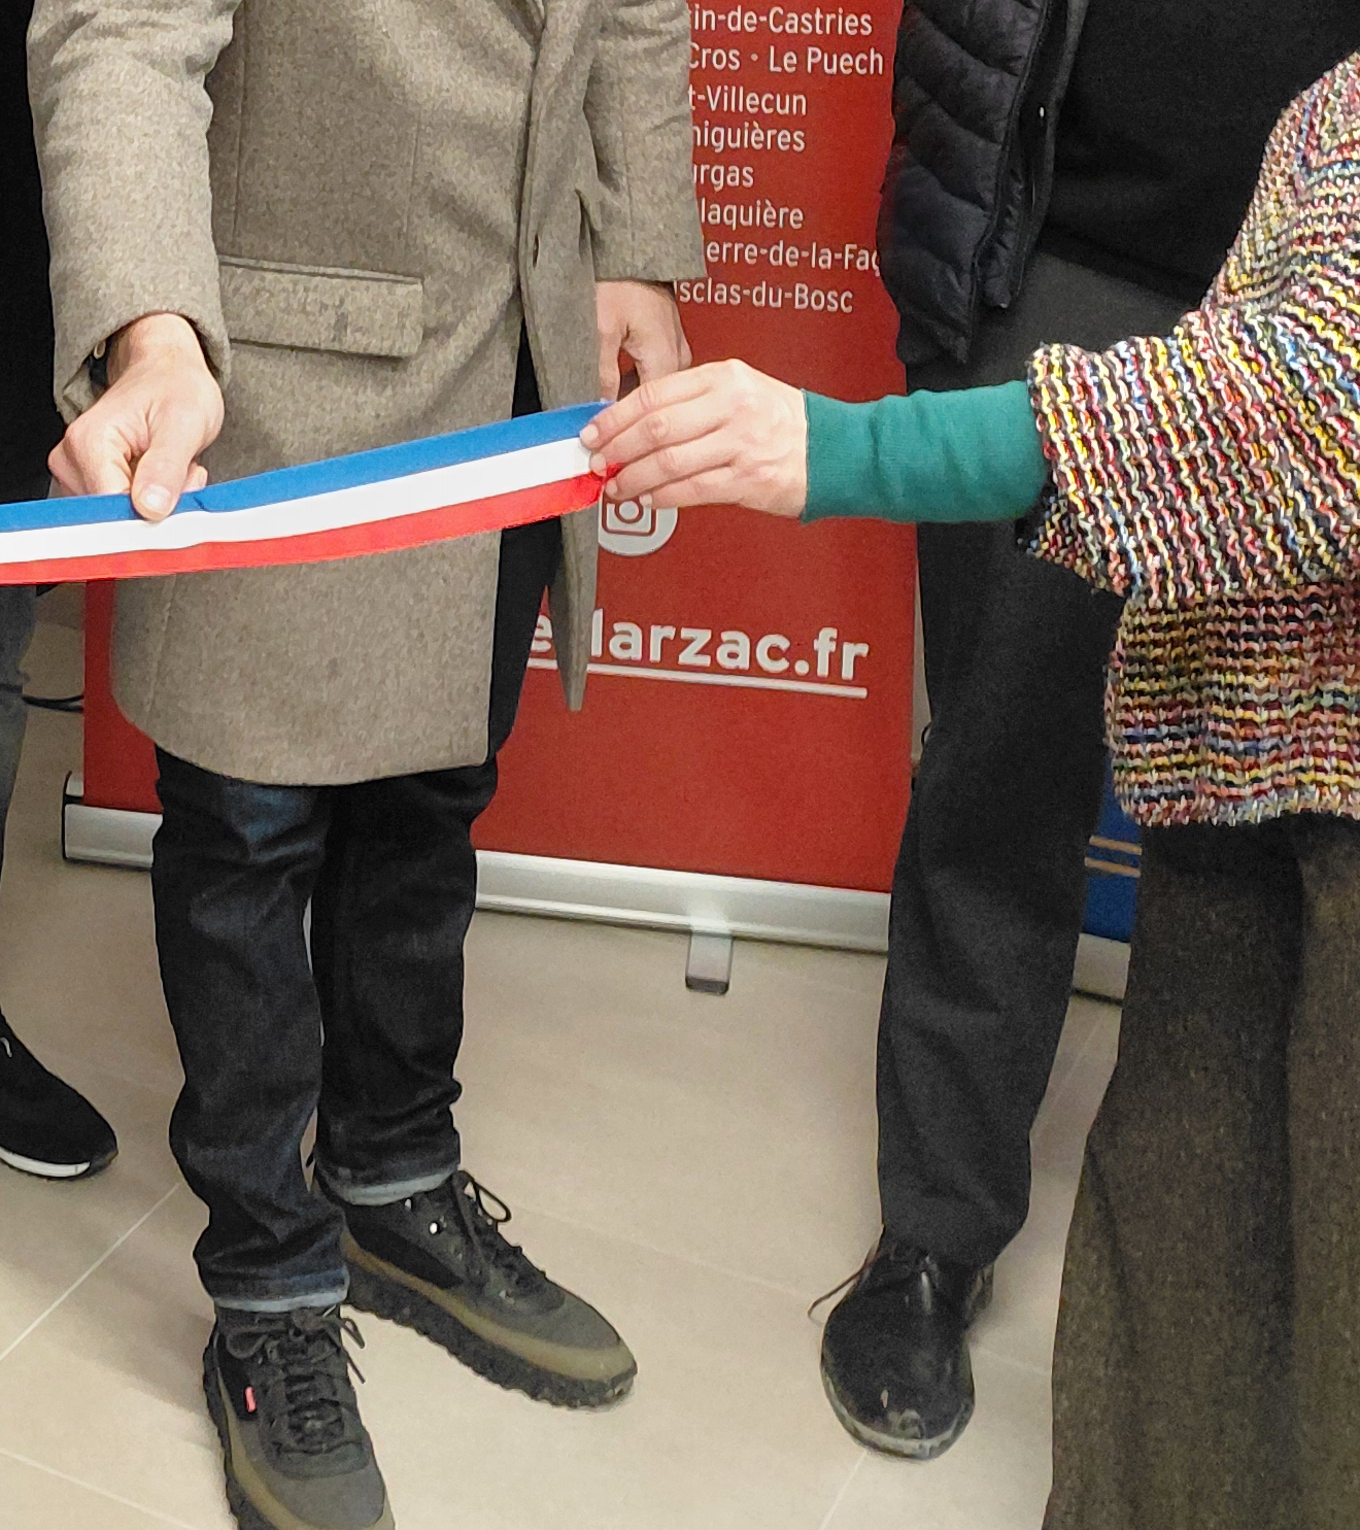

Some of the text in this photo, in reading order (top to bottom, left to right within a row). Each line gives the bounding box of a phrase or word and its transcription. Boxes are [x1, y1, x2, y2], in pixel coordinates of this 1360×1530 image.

[689, 3, 873, 36] in-de-Castries
[769, 45, 798, 73] Le
[807, 46, 884, 75] Puech
[700, 196, 804, 231] laquière
[674, 276, 853, 313] sclas-du-Bosc
